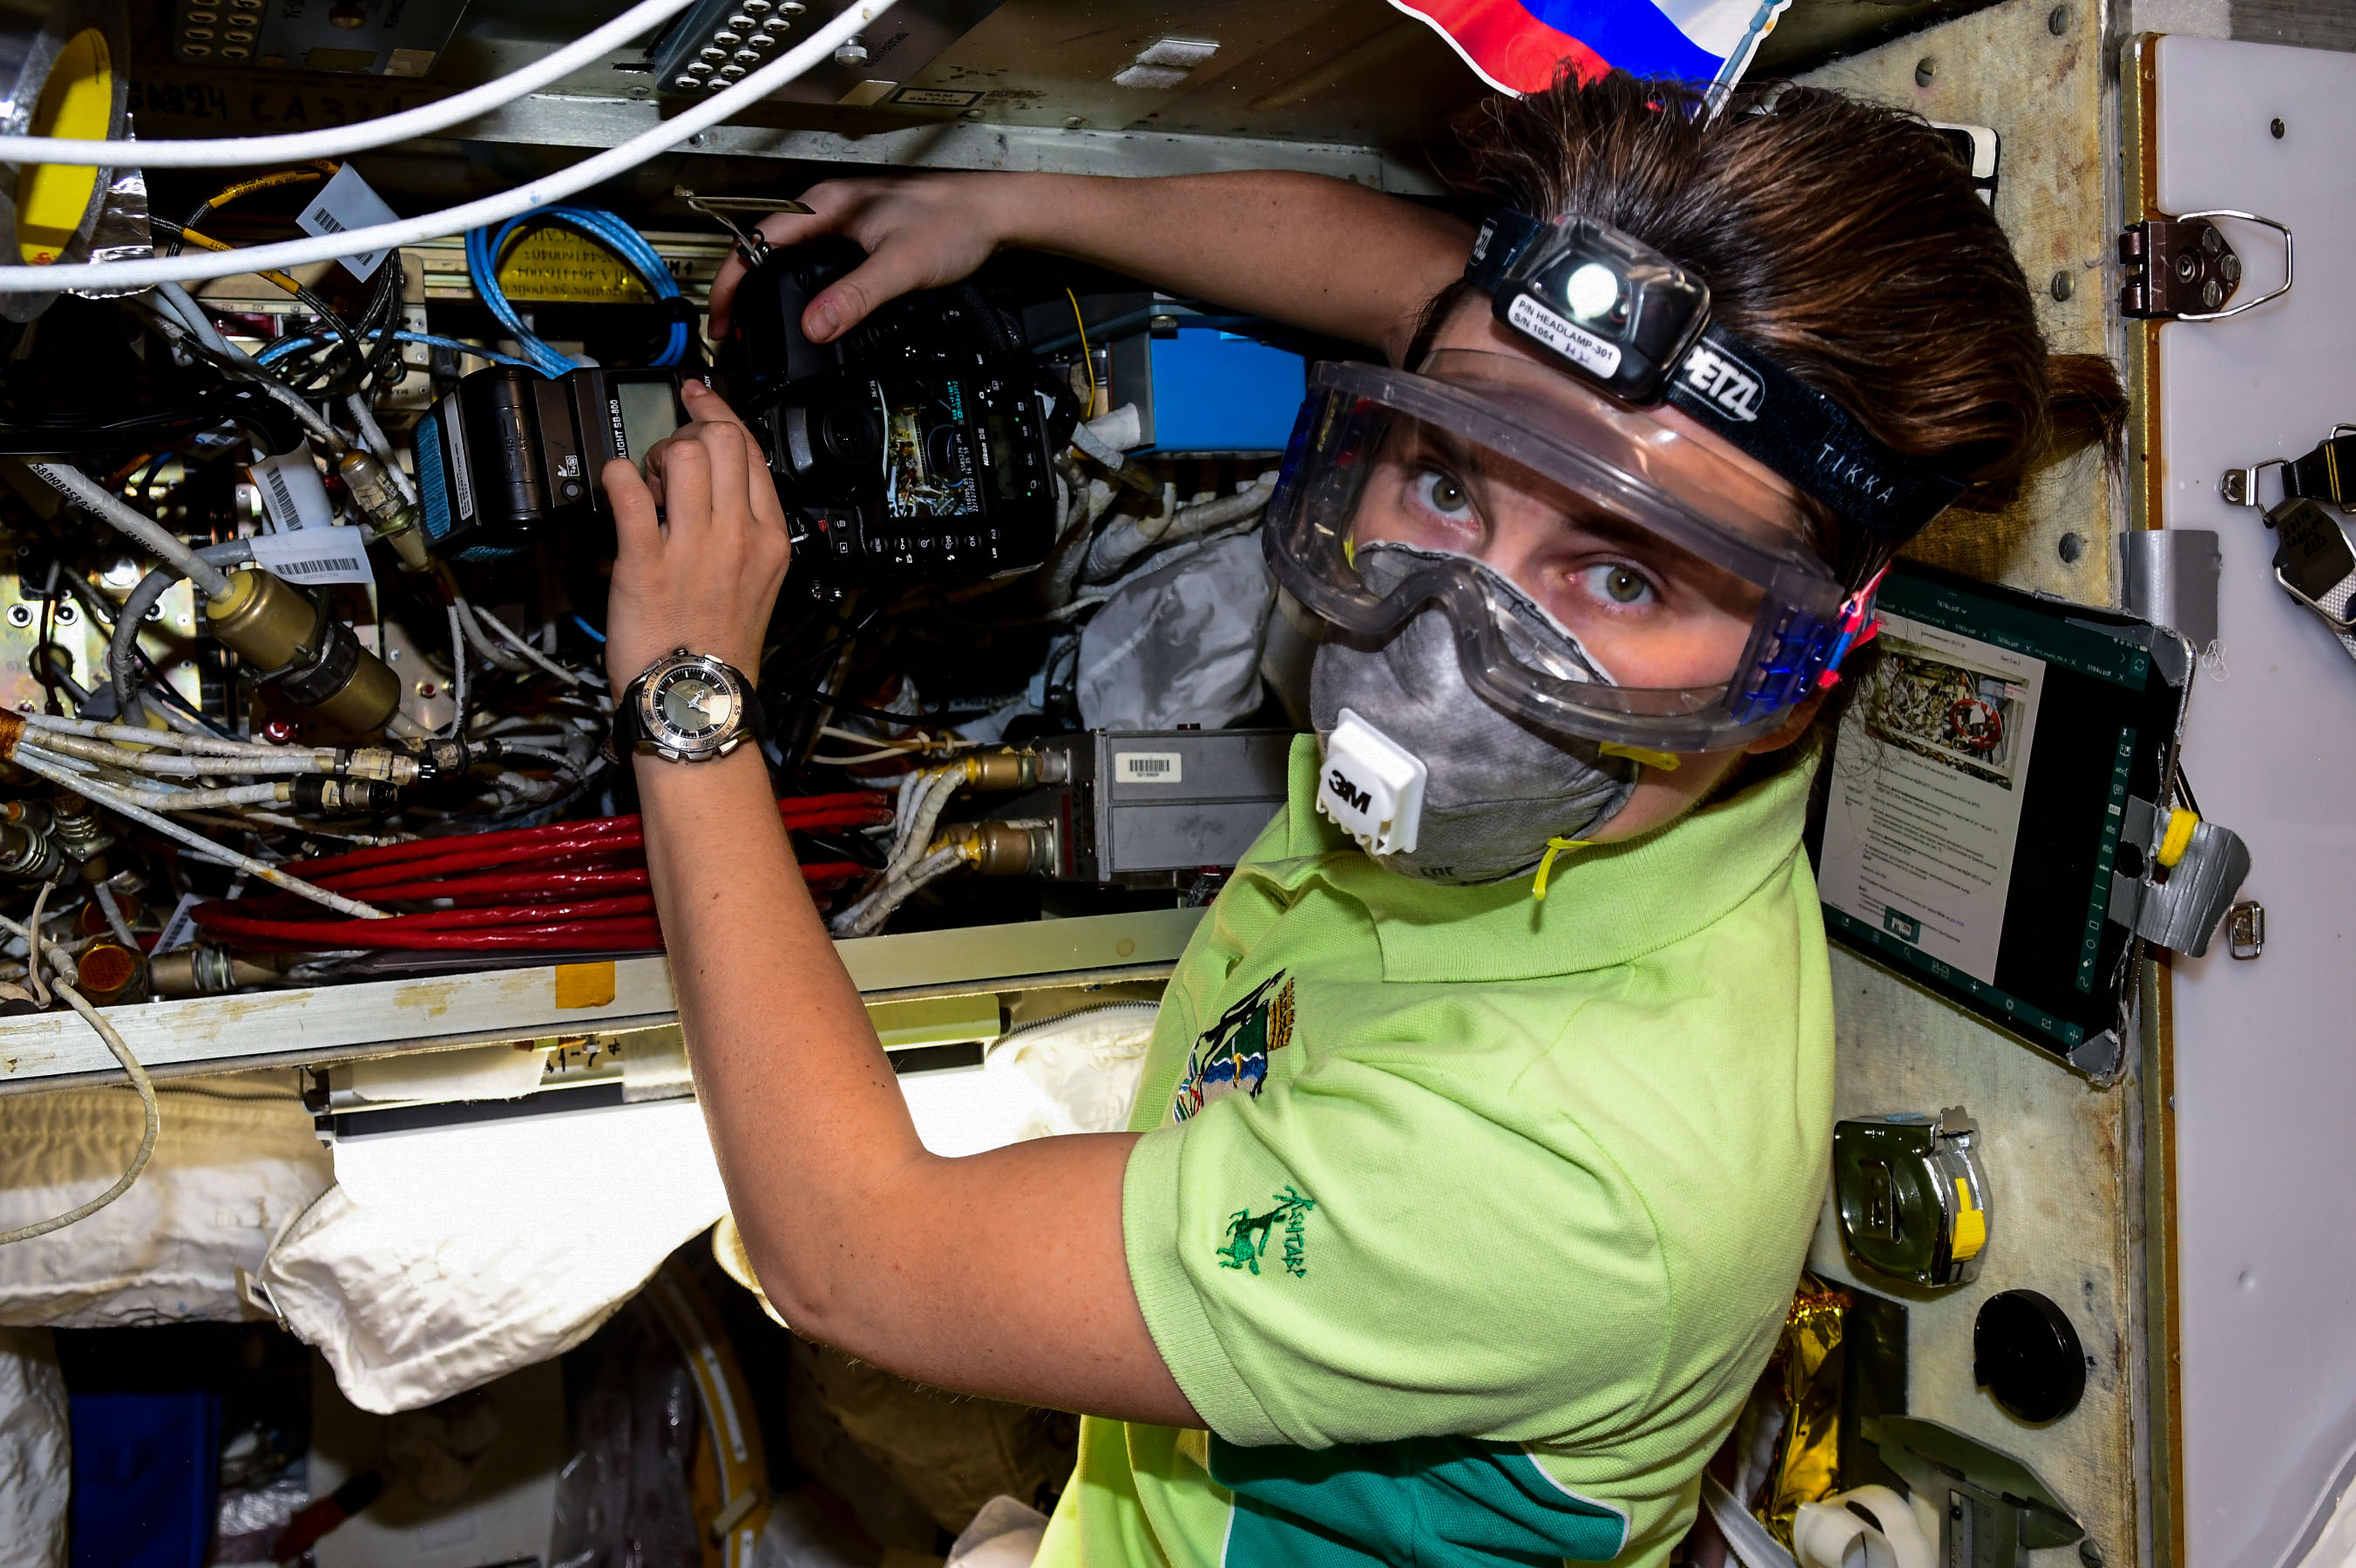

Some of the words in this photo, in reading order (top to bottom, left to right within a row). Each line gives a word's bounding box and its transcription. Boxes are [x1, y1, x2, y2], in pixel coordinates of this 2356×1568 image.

[1514, 312, 1531, 328] S/N
[1519, 300, 1534, 315] P/N
[1536, 311, 1613, 361] HEADLAMP-301
[610, 399, 622, 429] SB-800
[981, 442, 991, 466] Nikon
[1818, 443, 1895, 505] TIKKA
[969, 536, 977, 547] OK
[1328, 769, 1372, 814] 3M
